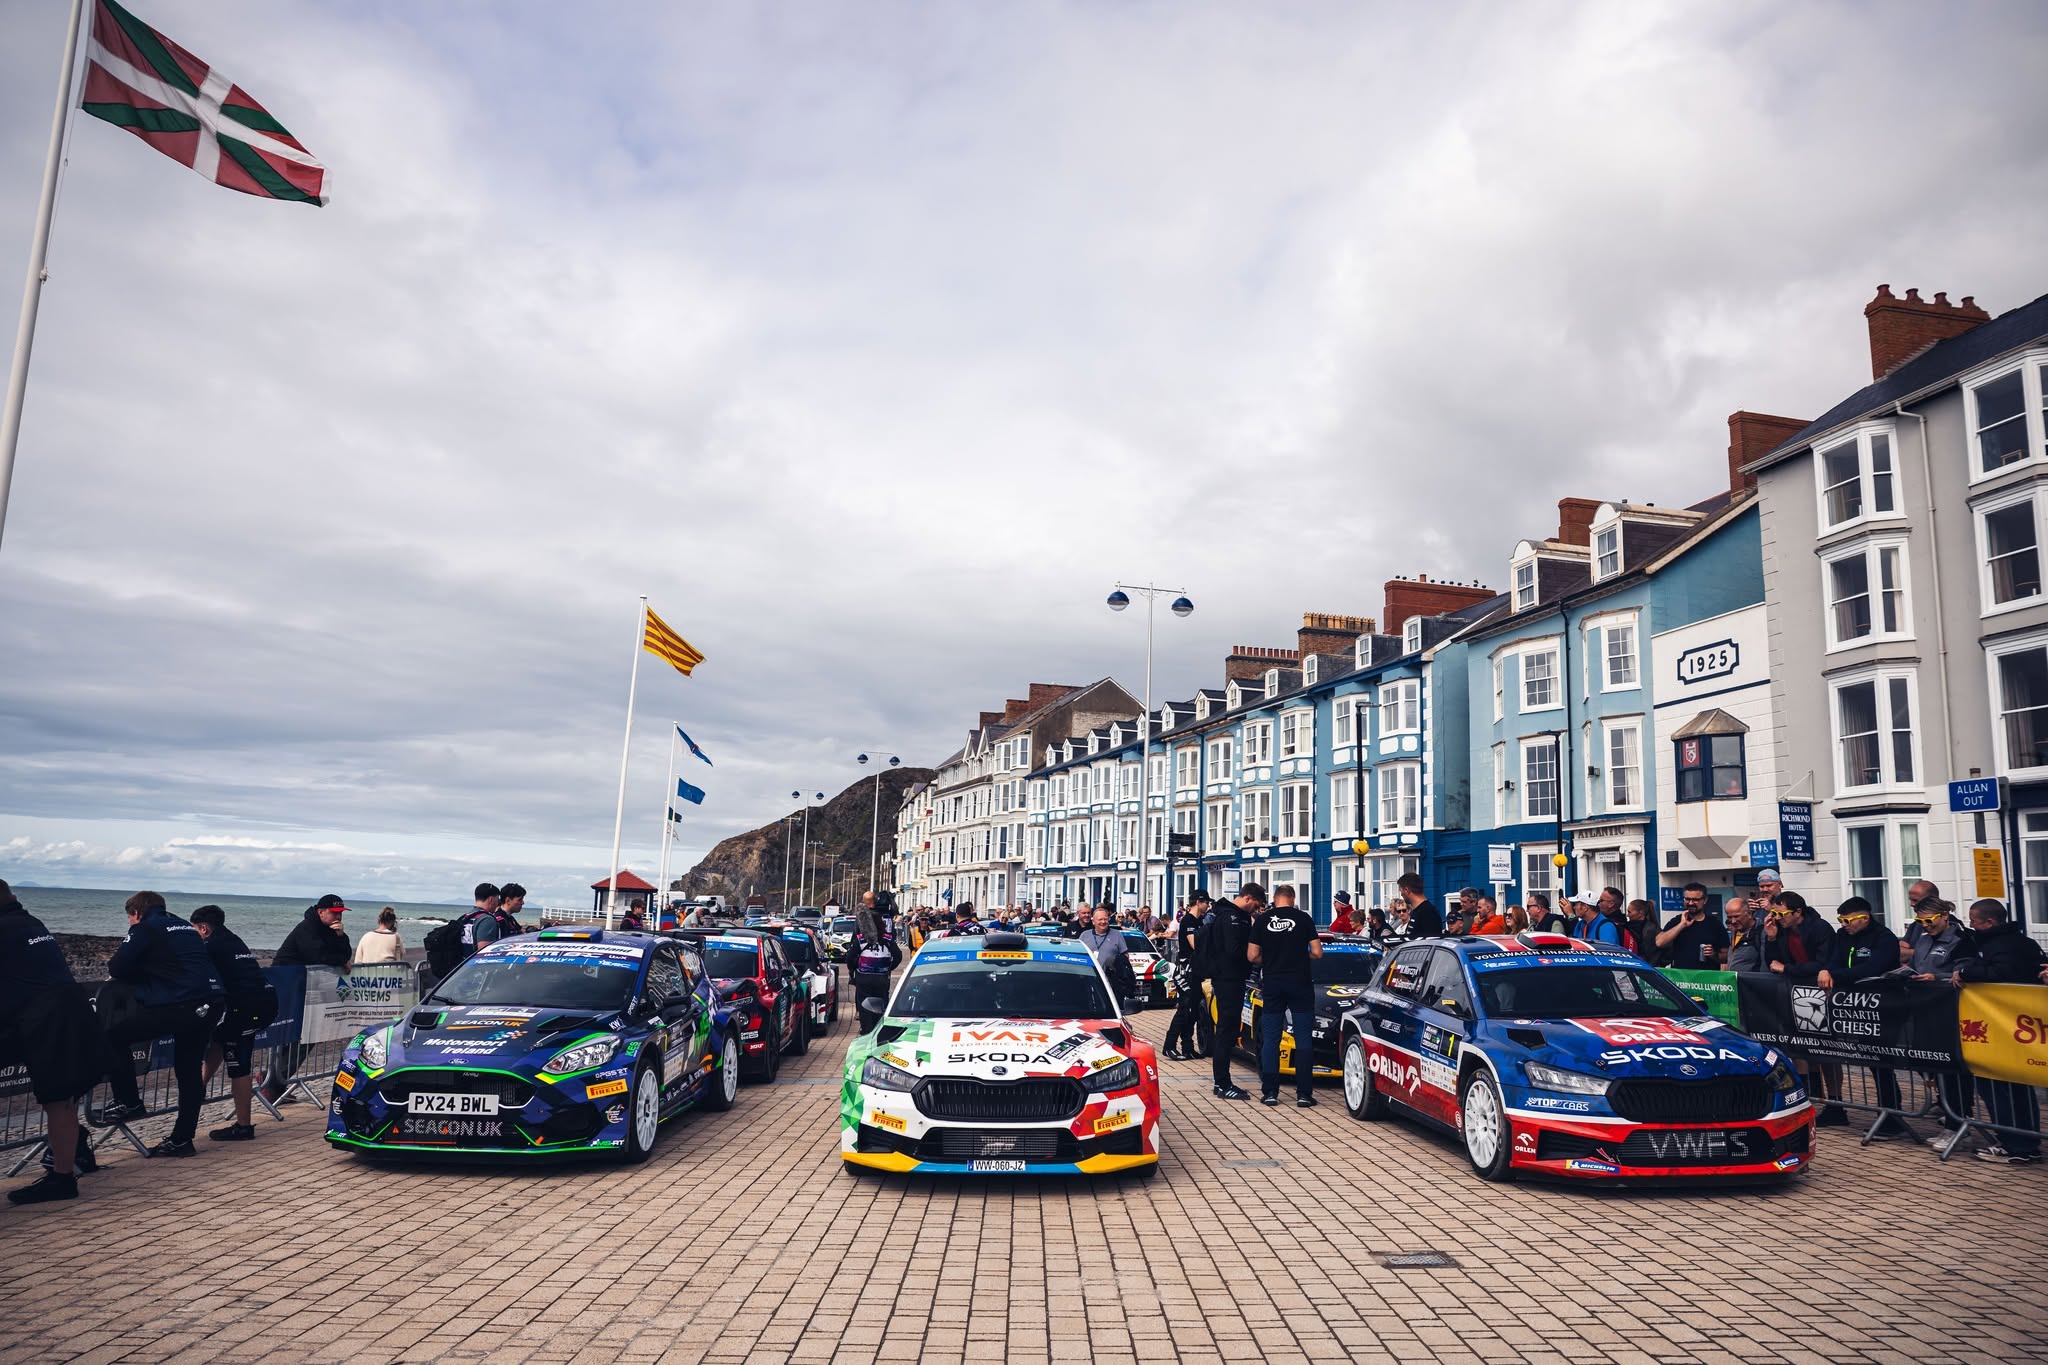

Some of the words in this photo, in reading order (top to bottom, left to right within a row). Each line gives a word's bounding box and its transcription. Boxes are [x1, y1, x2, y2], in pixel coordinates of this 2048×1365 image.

[1690, 650, 1728, 675] 1925
[1957, 783, 1988, 794] ALLAN
[1963, 796, 1984, 806] OUT
[1782, 814, 1810, 823] RICHMOND
[1578, 825, 1624, 838] ATLANTIC
[1273, 921, 1290, 929] LOTTO
[520, 943, 587, 951] Motorsport
[588, 945, 633, 953] Ireland
[1474, 951, 1540, 960] VOLKSWAGEN
[1592, 951, 1633, 959] SERVICES
[350, 976, 403, 989] SIGNATURE
[1704, 984, 1734, 992] LLWYDDO.
[354, 990, 392, 1002] SYSTEMS
[1832, 991, 1881, 1008] CAWS
[1832, 1008, 1880, 1021] CENARTH
[1832, 1020, 1881, 1036] CHEESE
[423, 1038, 507, 1047] Motorsport
[952, 1031, 1050, 1043] IVAR
[1072, 1035, 1086, 1044] 2
[1611, 1032, 1700, 1043] ORLEN
[441, 1046, 497, 1055] Ireland
[1448, 1033, 1455, 1057] 1
[1779, 1035, 1789, 1043] OF
[1790, 1036, 1820, 1046] AWARD
[1820, 1039, 1856, 1050] WINNING
[1857, 1043, 1905, 1057] SPECIALITY
[1908, 1049, 1951, 1061] CHEESES
[948, 1053, 1052, 1065] SKODA
[1600, 1046, 1748, 1065] SKODA
[1369, 1052, 1404, 1086] ORLEN
[590, 1082, 624, 1096] PIRELLI
[414, 1095, 456, 1111] PX24
[460, 1097, 492, 1113] BWL
[1537, 1097, 1557, 1107] TOP
[1563, 1101, 1589, 1111] CARS
[404, 1118, 474, 1136] SEACON
[476, 1121, 503, 1136] UK
[874, 1113, 904, 1130] PIRELLI
[1098, 1114, 1128, 1130] PIRELLI
[1514, 1146, 1536, 1154] ORLEN
[1648, 1131, 1750, 1159] VWFS
[975, 1161, 1025, 1171] WW-060-JZ
[1580, 1163, 1615, 1171] MICHELIN
